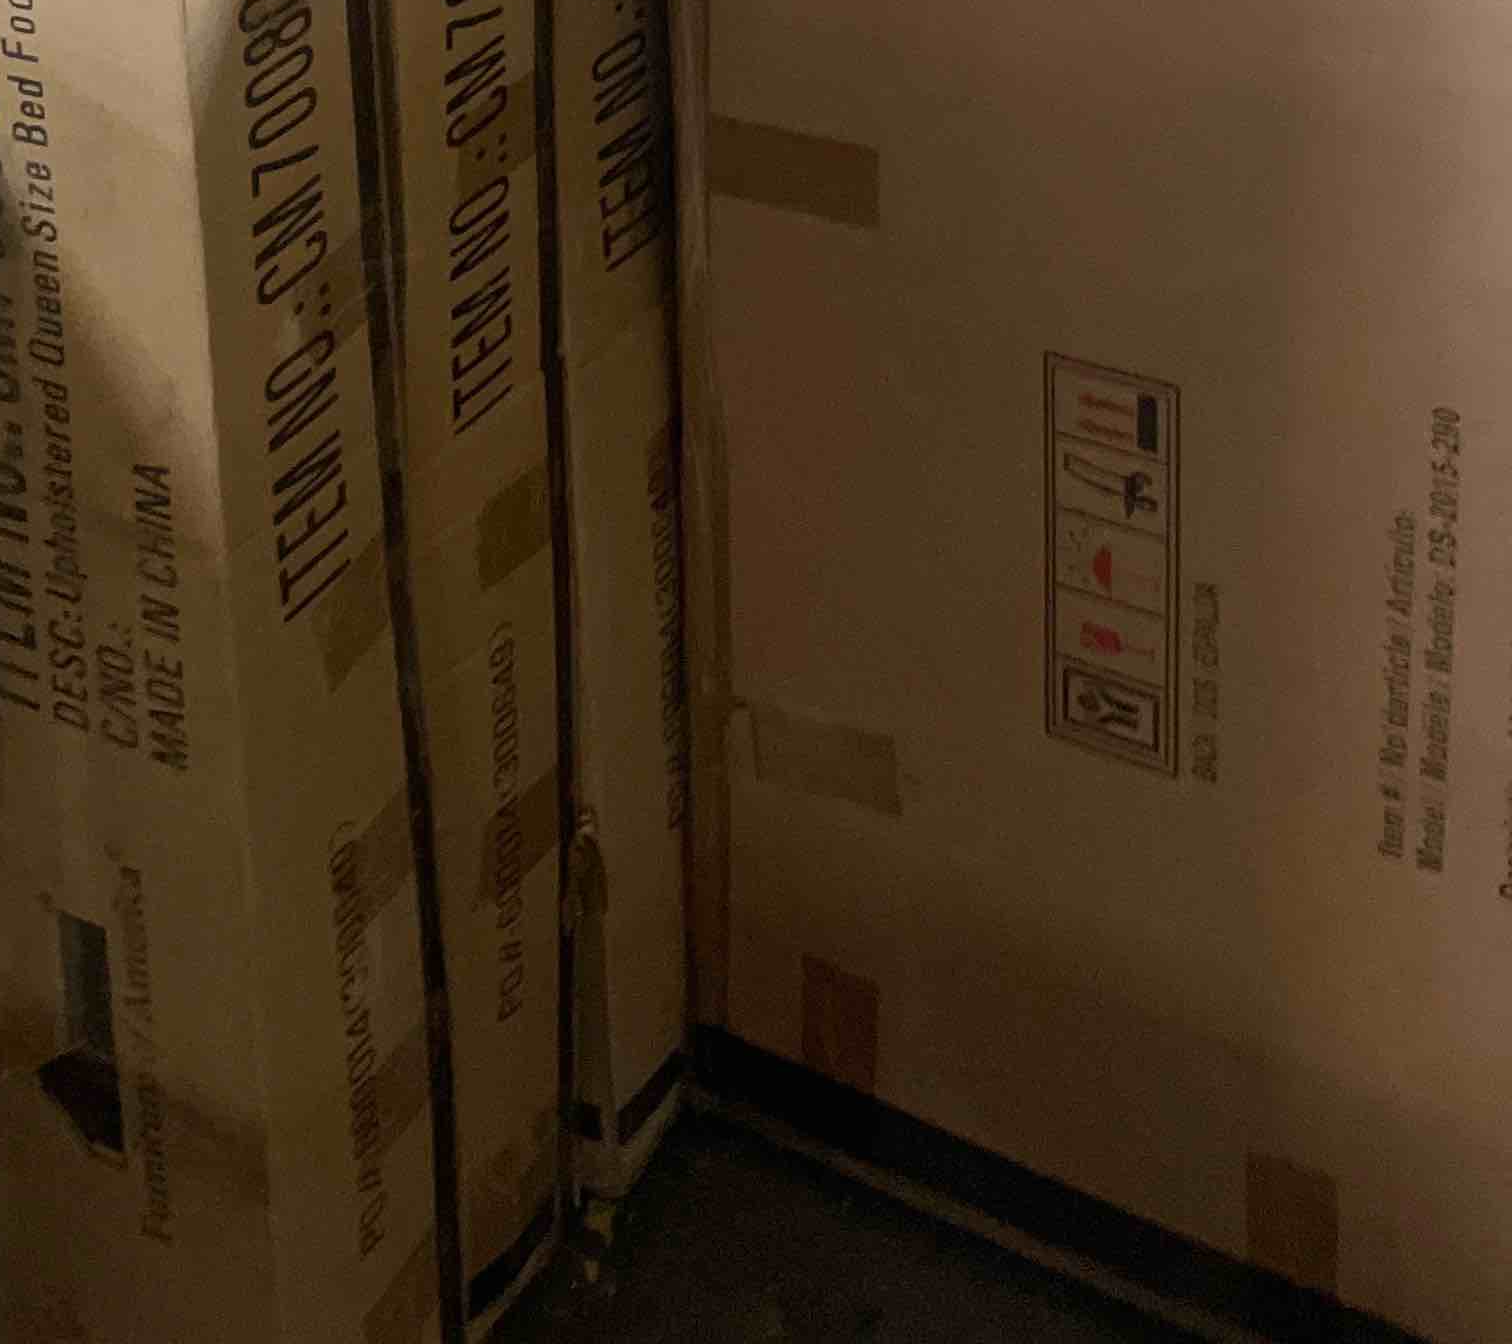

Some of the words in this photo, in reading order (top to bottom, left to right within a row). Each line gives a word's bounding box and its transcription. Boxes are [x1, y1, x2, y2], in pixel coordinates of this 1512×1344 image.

[7, 74, 49, 148] Bed
[20, 159, 58, 243] Size
[597, 114, 660, 272] ITEM
[27, 248, 68, 367] Queen
[449, 265, 513, 436] ITEM
[132, 463, 180, 590] CHINA
[269, 427, 353, 625] ITEM
[139, 592, 181, 642] IN
[142, 650, 189, 772] MADE
